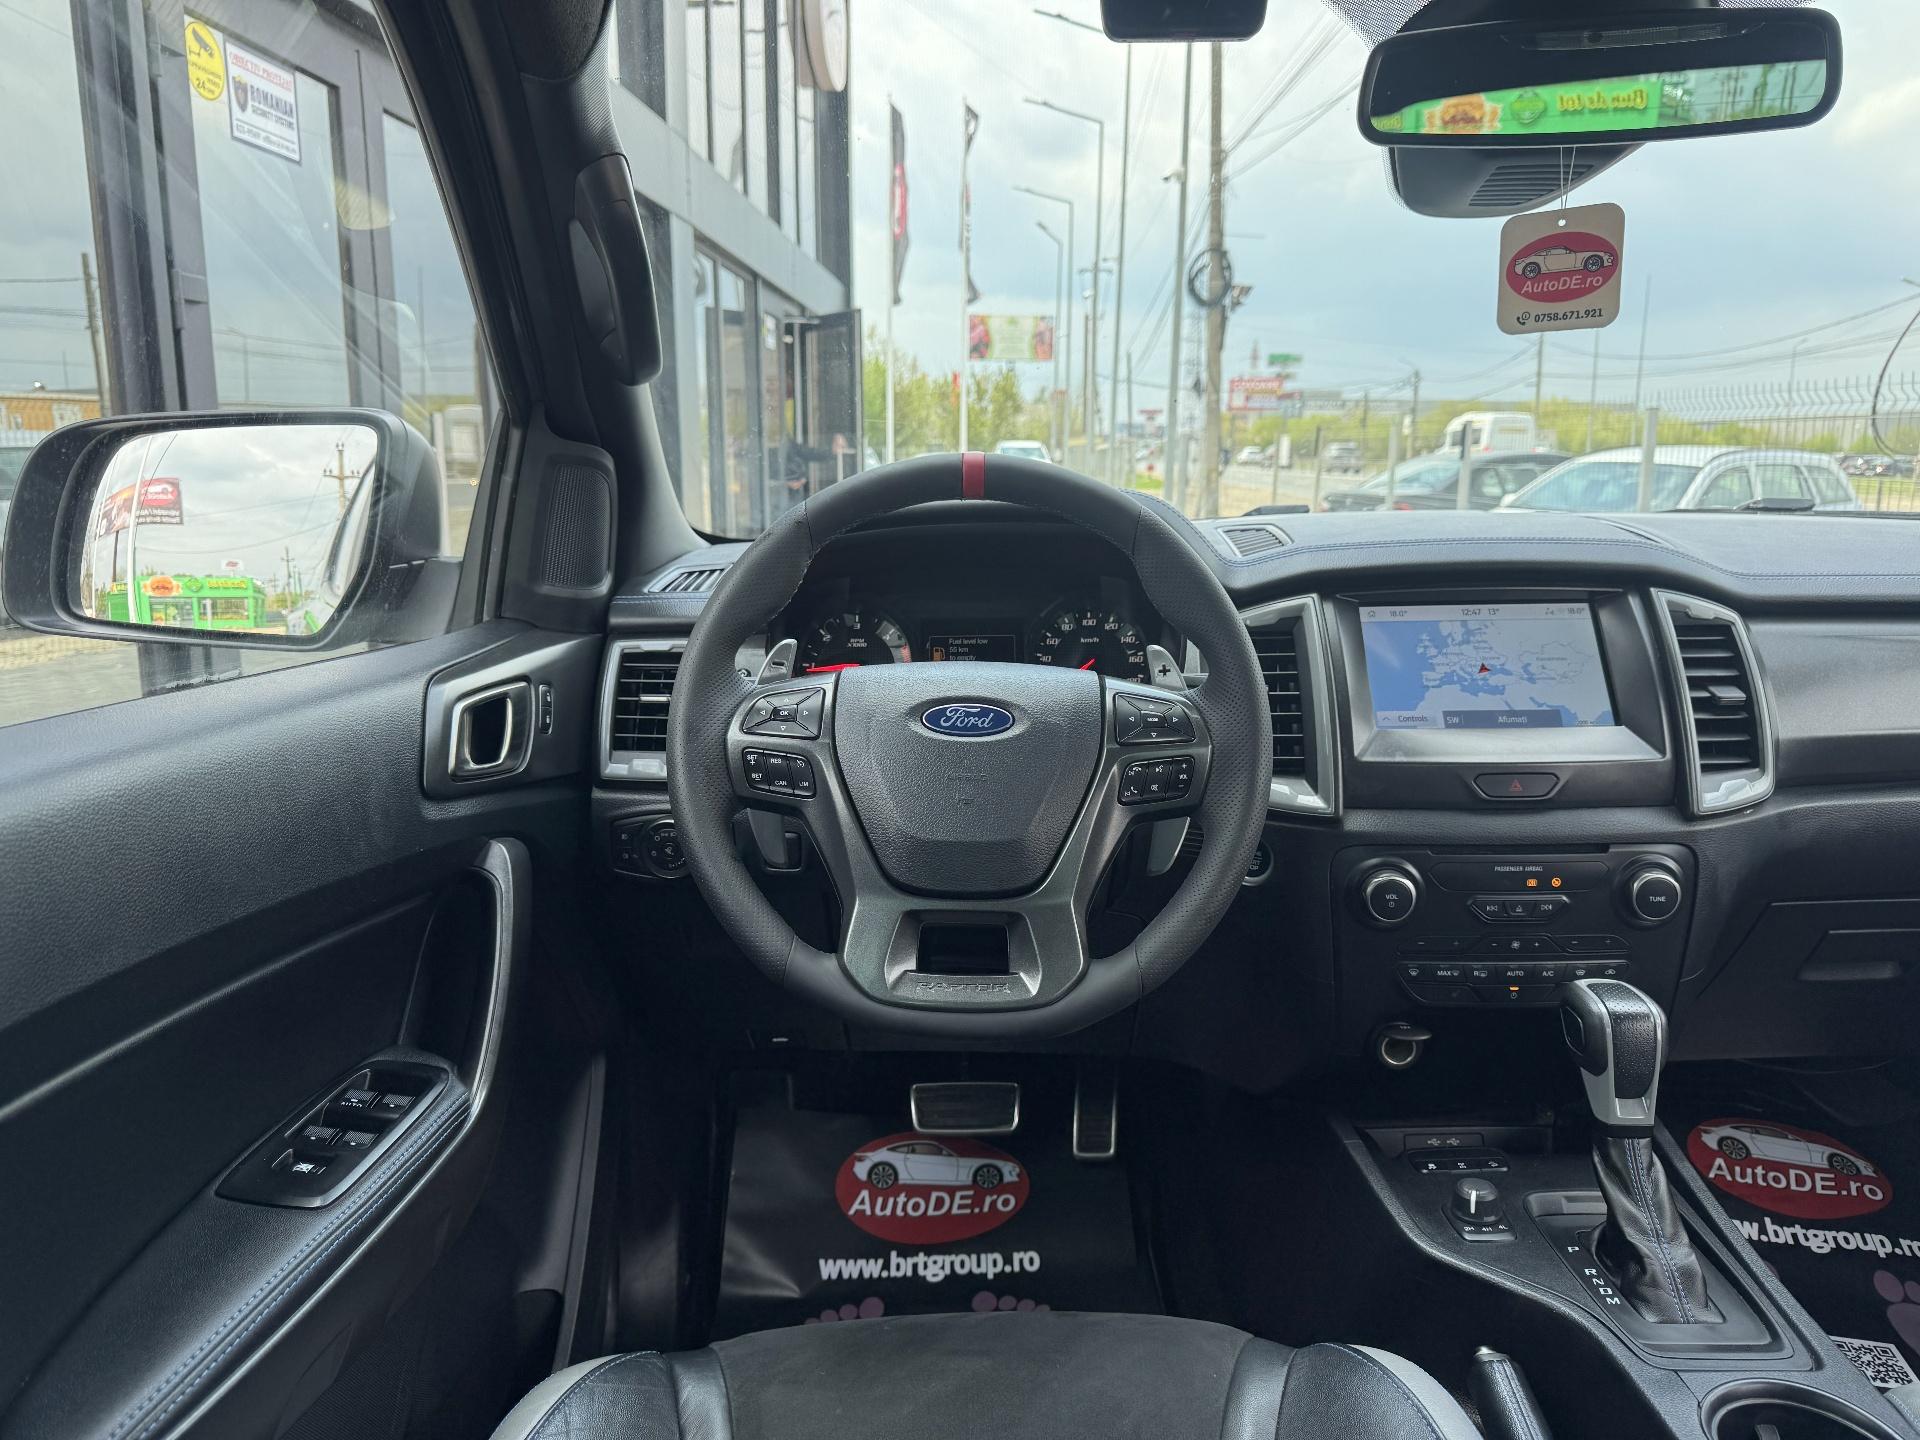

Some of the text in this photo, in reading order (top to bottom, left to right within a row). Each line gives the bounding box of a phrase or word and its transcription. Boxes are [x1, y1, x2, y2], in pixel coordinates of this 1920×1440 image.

[250, 85, 294, 118] ROMANIAN
[1520, 275, 1604, 294] AutoDE.ro
[1534, 308, 1604, 323] 0758.671.921
[1461, 608, 1481, 616] 12:47
[940, 706, 995, 728] Ford
[1398, 715, 1428, 723] Controls
[1446, 716, 1459, 724] SW
[1708, 1157, 1884, 1201] AutoDE.ro
[848, 1189, 1016, 1217] AutoDE.ro
[819, 1250, 1041, 1282] www.brtgroup.ro
[1599, 1287, 1612, 1295] D
[1606, 1297, 1620, 1305] M
